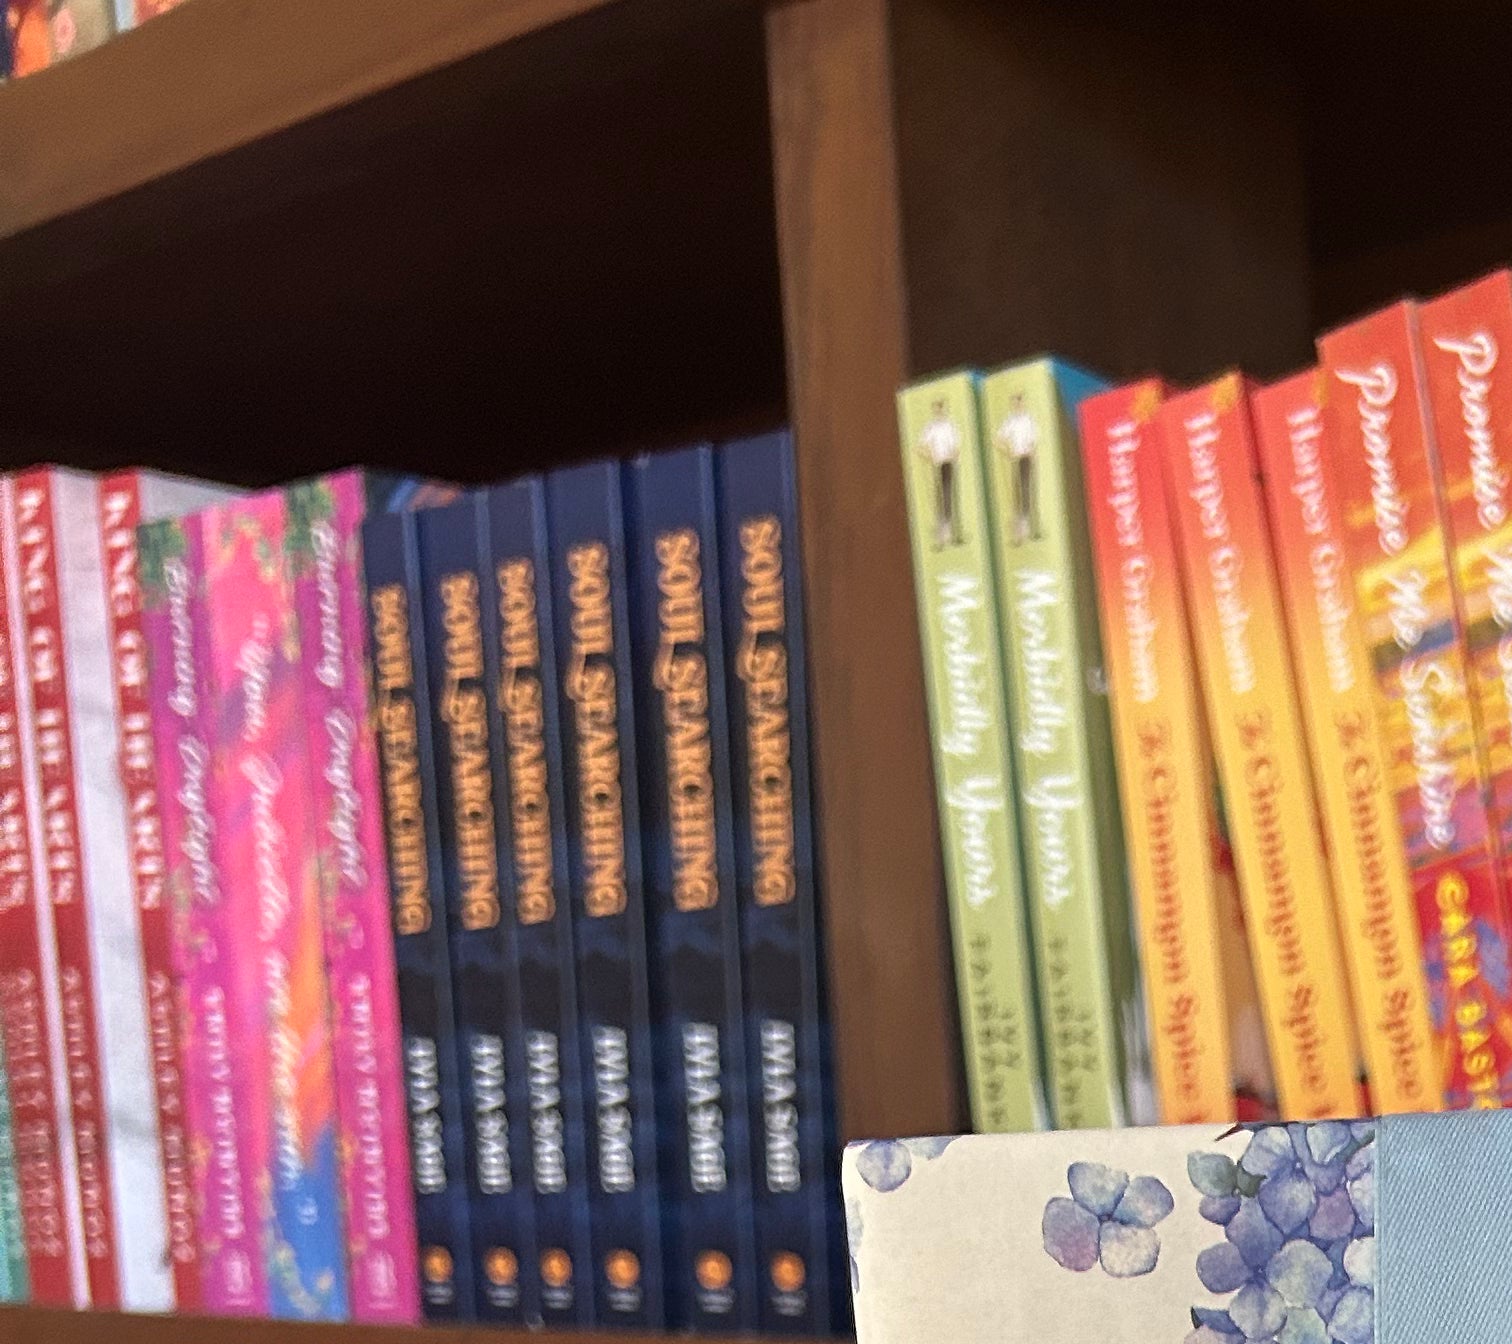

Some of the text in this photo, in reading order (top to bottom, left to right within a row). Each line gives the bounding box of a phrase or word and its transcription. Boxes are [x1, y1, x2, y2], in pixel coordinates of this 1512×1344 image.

[1106, 421, 1159, 702] Harper Graham
[1184, 413, 1255, 693] Harper Graham
[1286, 407, 1353, 693] Harper Graham
[1432, 333, 1509, 531] Promise
[1016, 568, 1080, 907] Morbidly Yours
[1334, 362, 1456, 850] Promise Me Sunshine
[440, 689, 500, 930] SEARCHING
[498, 676, 555, 924] SEARCHING
[566, 664, 626, 917] SEARCHING
[653, 653, 718, 911] SEARCHING
[736, 643, 795, 906] SEARCHING
[938, 572, 1003, 907] Morbidly Yours
[1148, 766, 1189, 985] Cinnamon
[1248, 755, 1306, 978] Cinnamon
[1282, 985, 1329, 1091] Spice
[1344, 755, 1404, 980] Cinnamon
[1381, 989, 1426, 1101] Spice
[1436, 872, 1476, 989] CARA
[1164, 993, 1203, 1102] Spice
